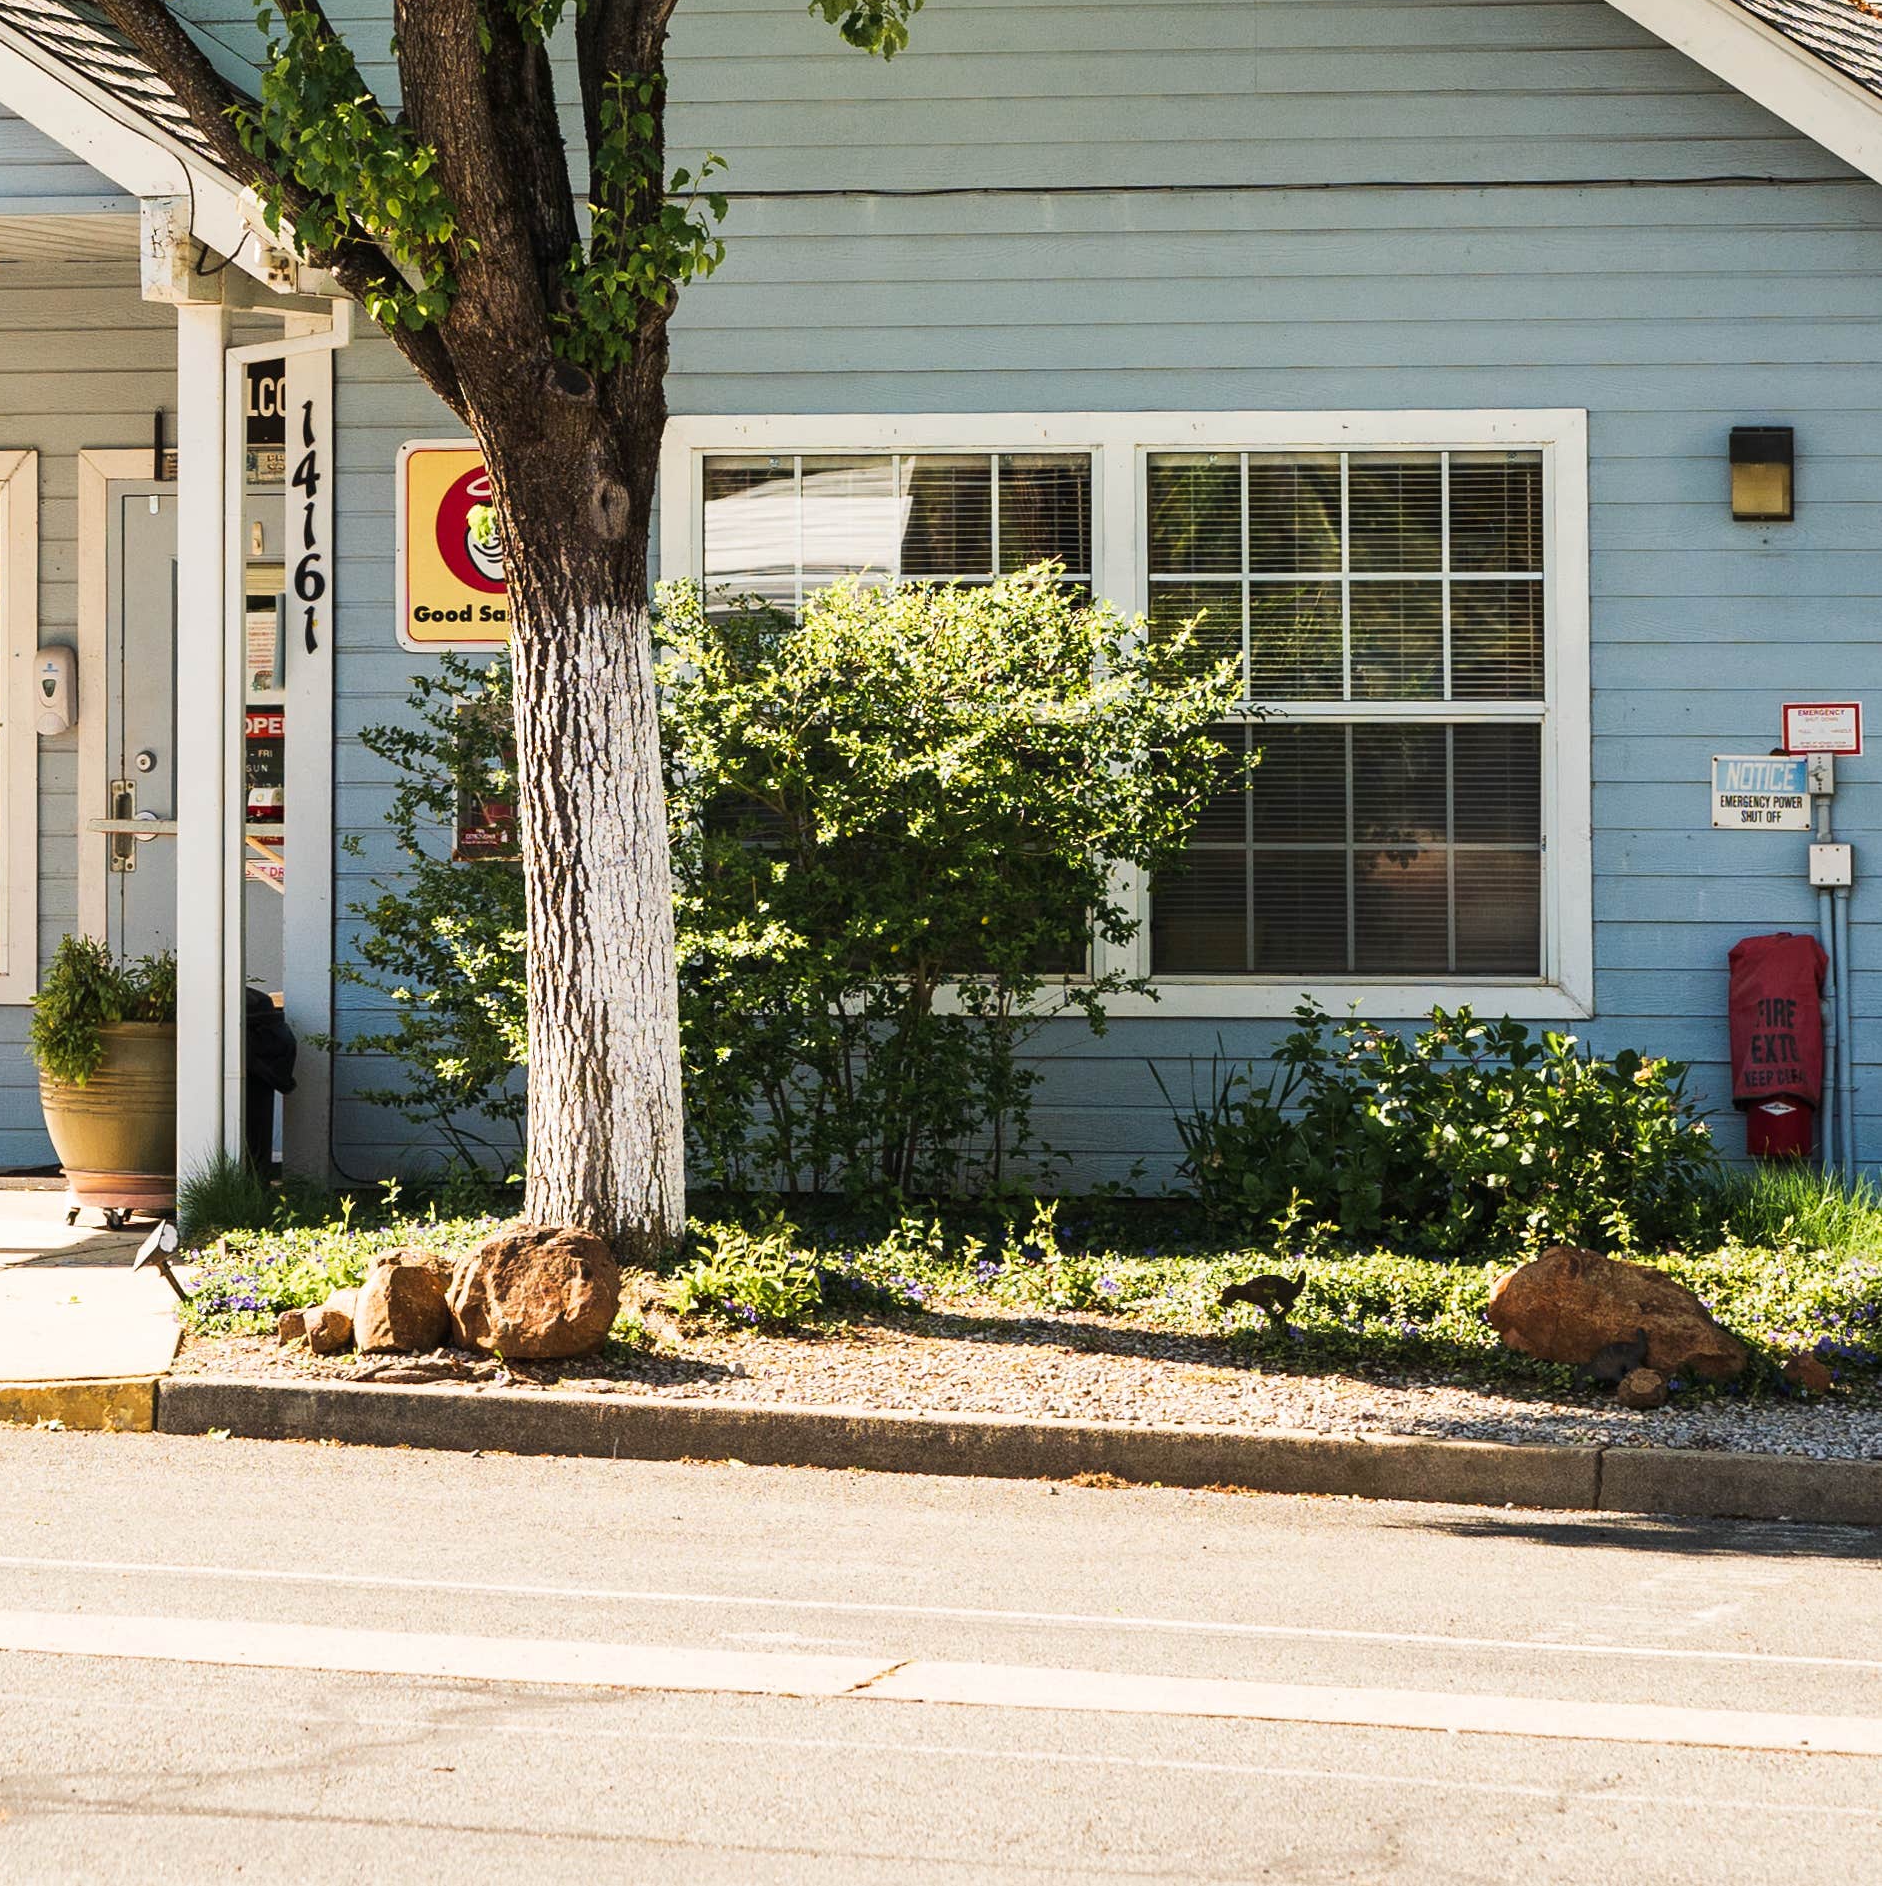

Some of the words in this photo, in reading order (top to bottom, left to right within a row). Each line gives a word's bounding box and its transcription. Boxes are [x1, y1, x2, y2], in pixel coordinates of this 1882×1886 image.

[292, 400, 325, 655] 14161
[414, 604, 472, 622] Good
[479, 605, 509, 622] Sa
[246, 717, 286, 734] OPE
[1726, 762, 1797, 791] NOTICE
[1720, 795, 1771, 808] EMERGENCY
[1773, 796, 1802, 809] POWER
[1741, 810, 1761, 823] SHUT
[1766, 811, 1782, 823] OFF
